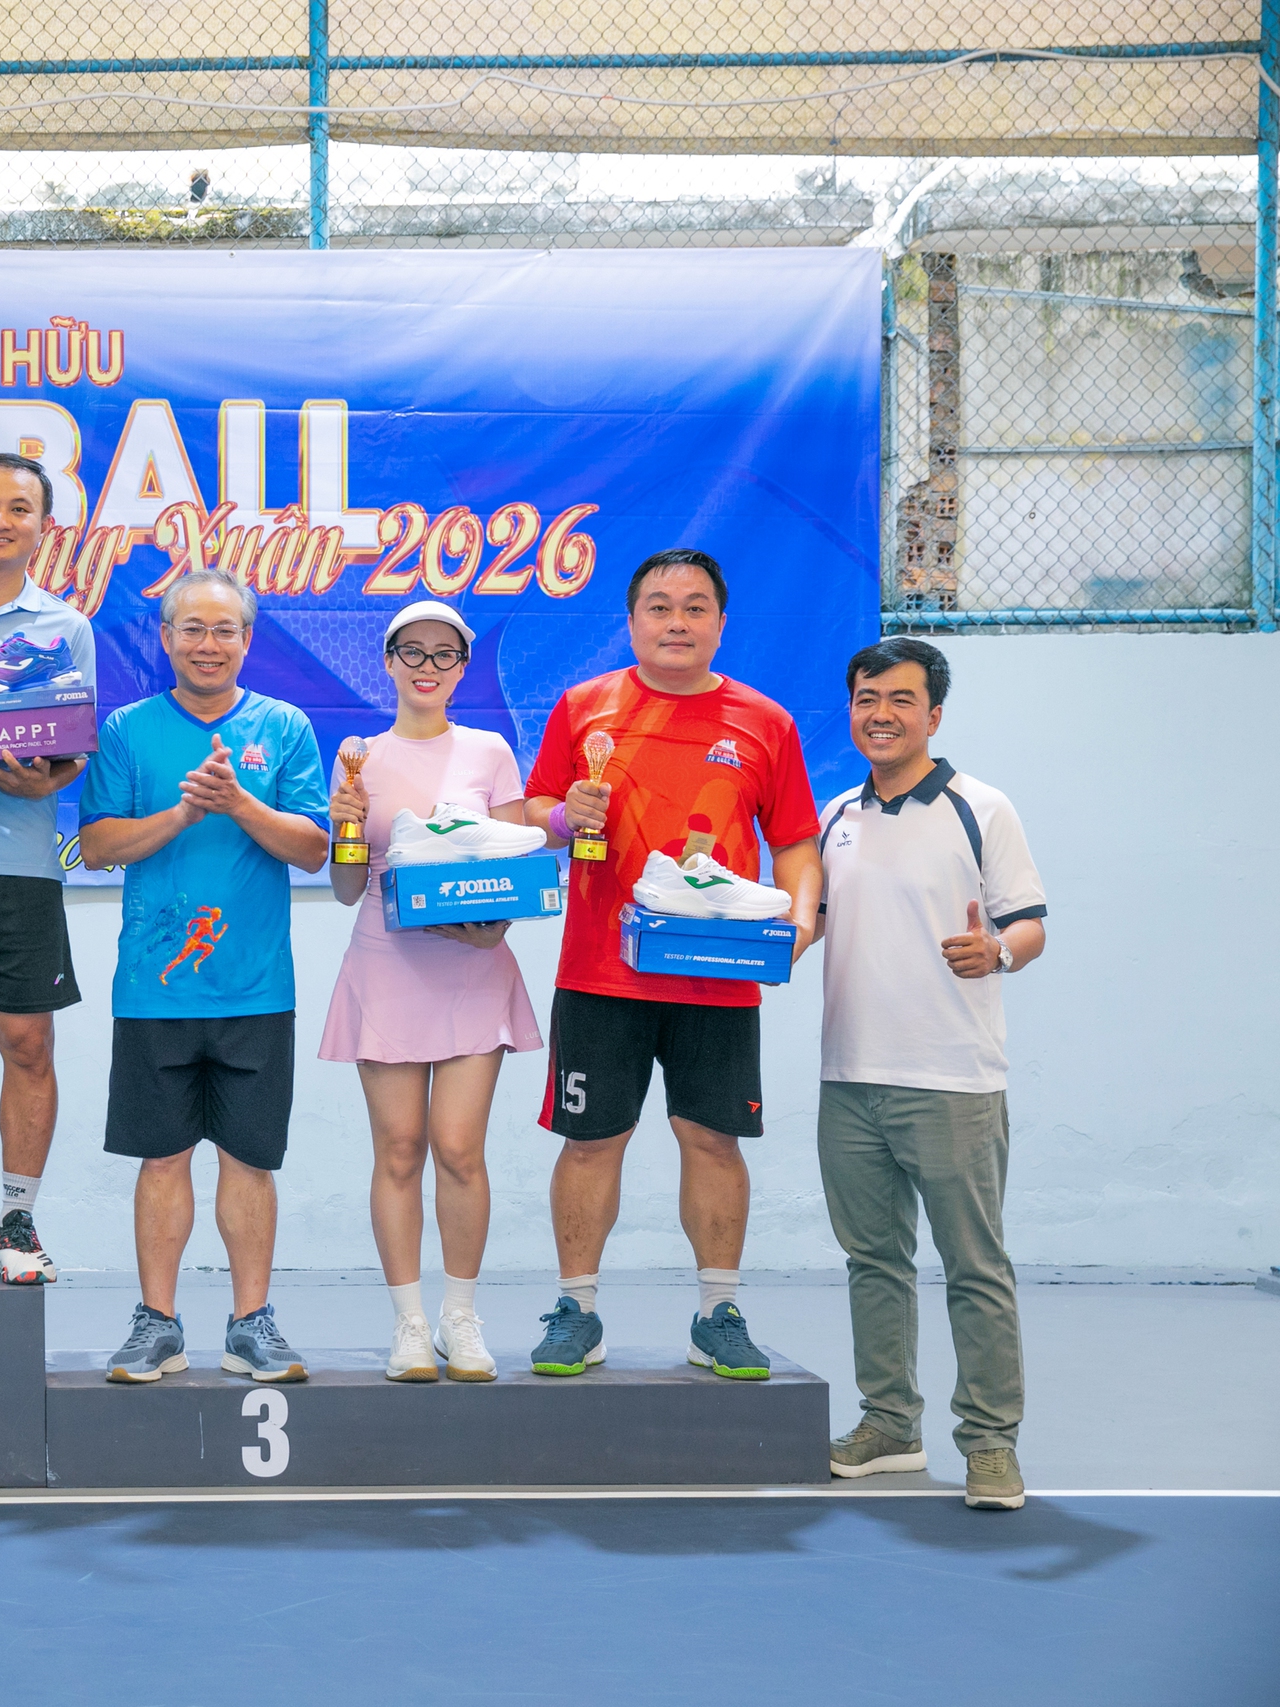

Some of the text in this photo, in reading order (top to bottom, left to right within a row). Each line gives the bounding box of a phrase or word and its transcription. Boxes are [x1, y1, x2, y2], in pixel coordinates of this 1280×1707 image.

[0, 314, 125, 387] HỮU
[141, 500, 349, 598] Xuân
[362, 501, 600, 598] 2026
[0, 722, 57, 742] APPT
[693, 956, 735, 964] PROFESSIONAL
[736, 958, 765, 966] ATHLETES
[241, 1388, 290, 1478] 3
